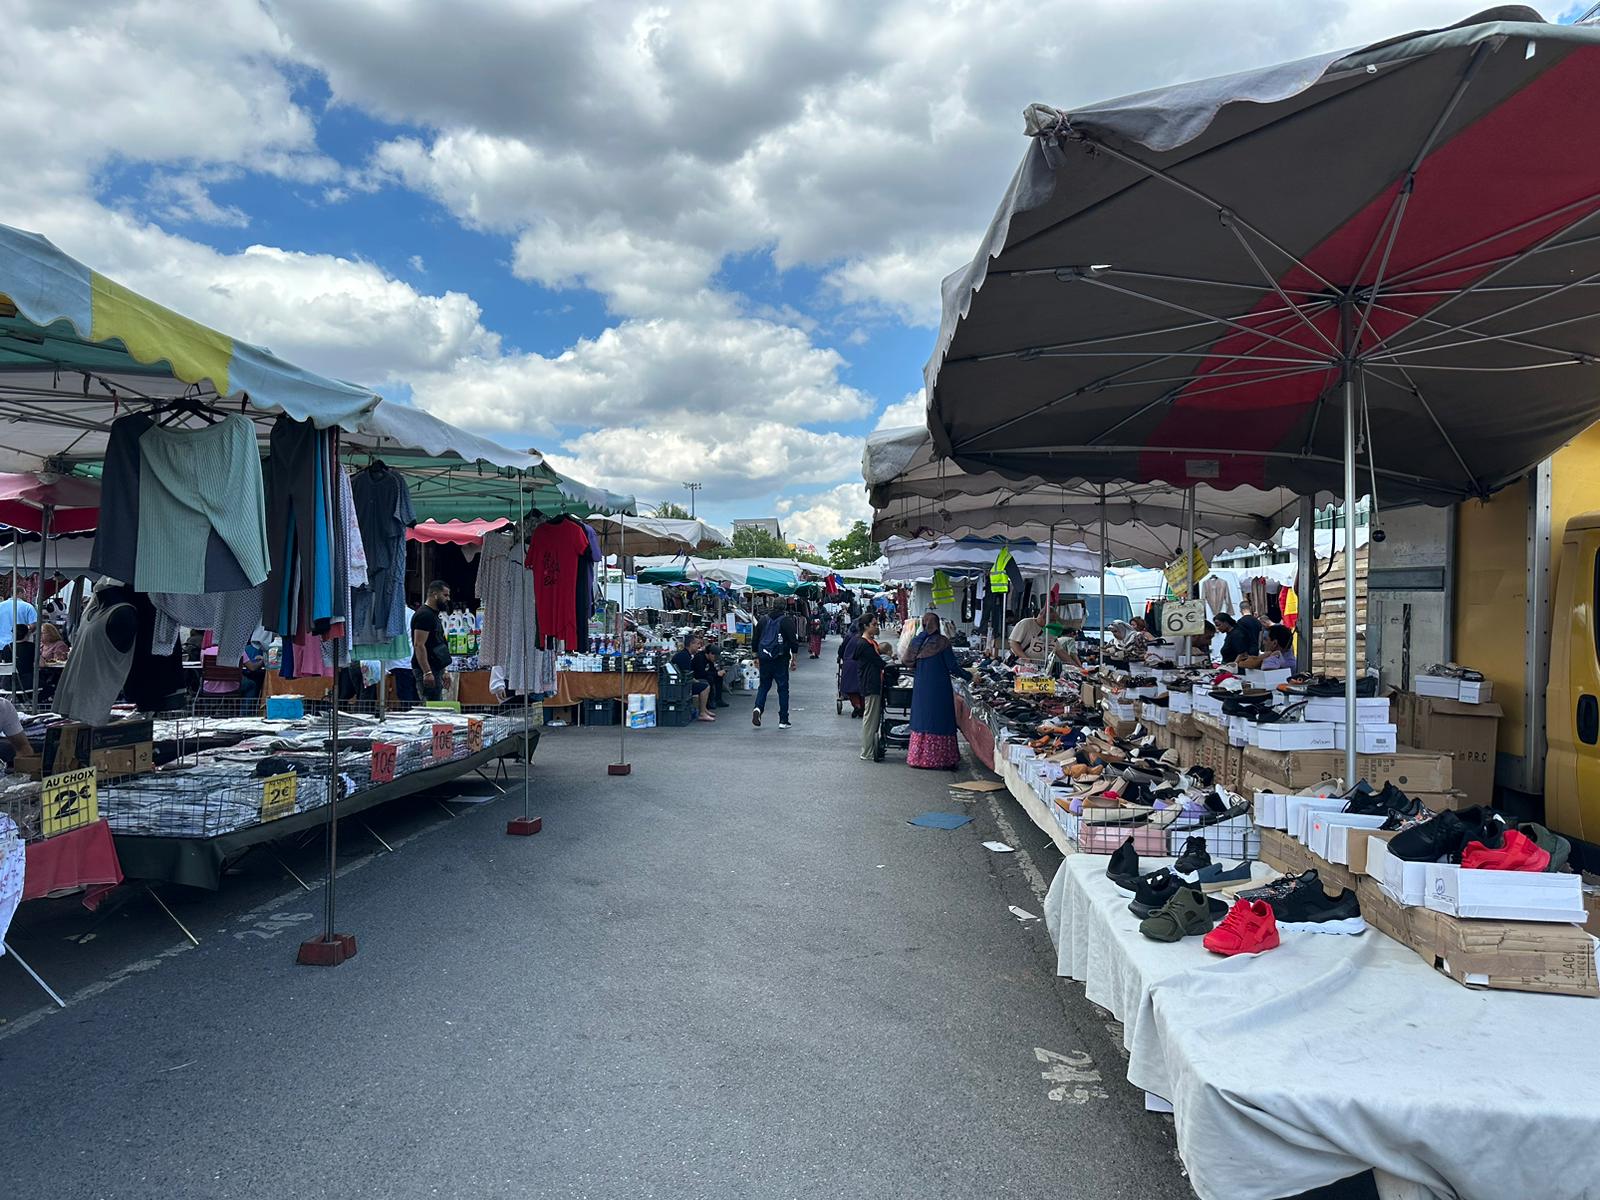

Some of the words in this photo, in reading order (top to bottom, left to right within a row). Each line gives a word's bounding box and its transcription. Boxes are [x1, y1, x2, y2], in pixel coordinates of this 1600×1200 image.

[1167, 611, 1197, 632] 6€
[433, 730, 453, 751] 10€
[373, 751, 395, 773] 10€
[45, 777, 60, 789] AU
[63, 769, 95, 784] CHOIX
[54, 784, 92, 820] 2€
[270, 786, 289, 805] 2€
